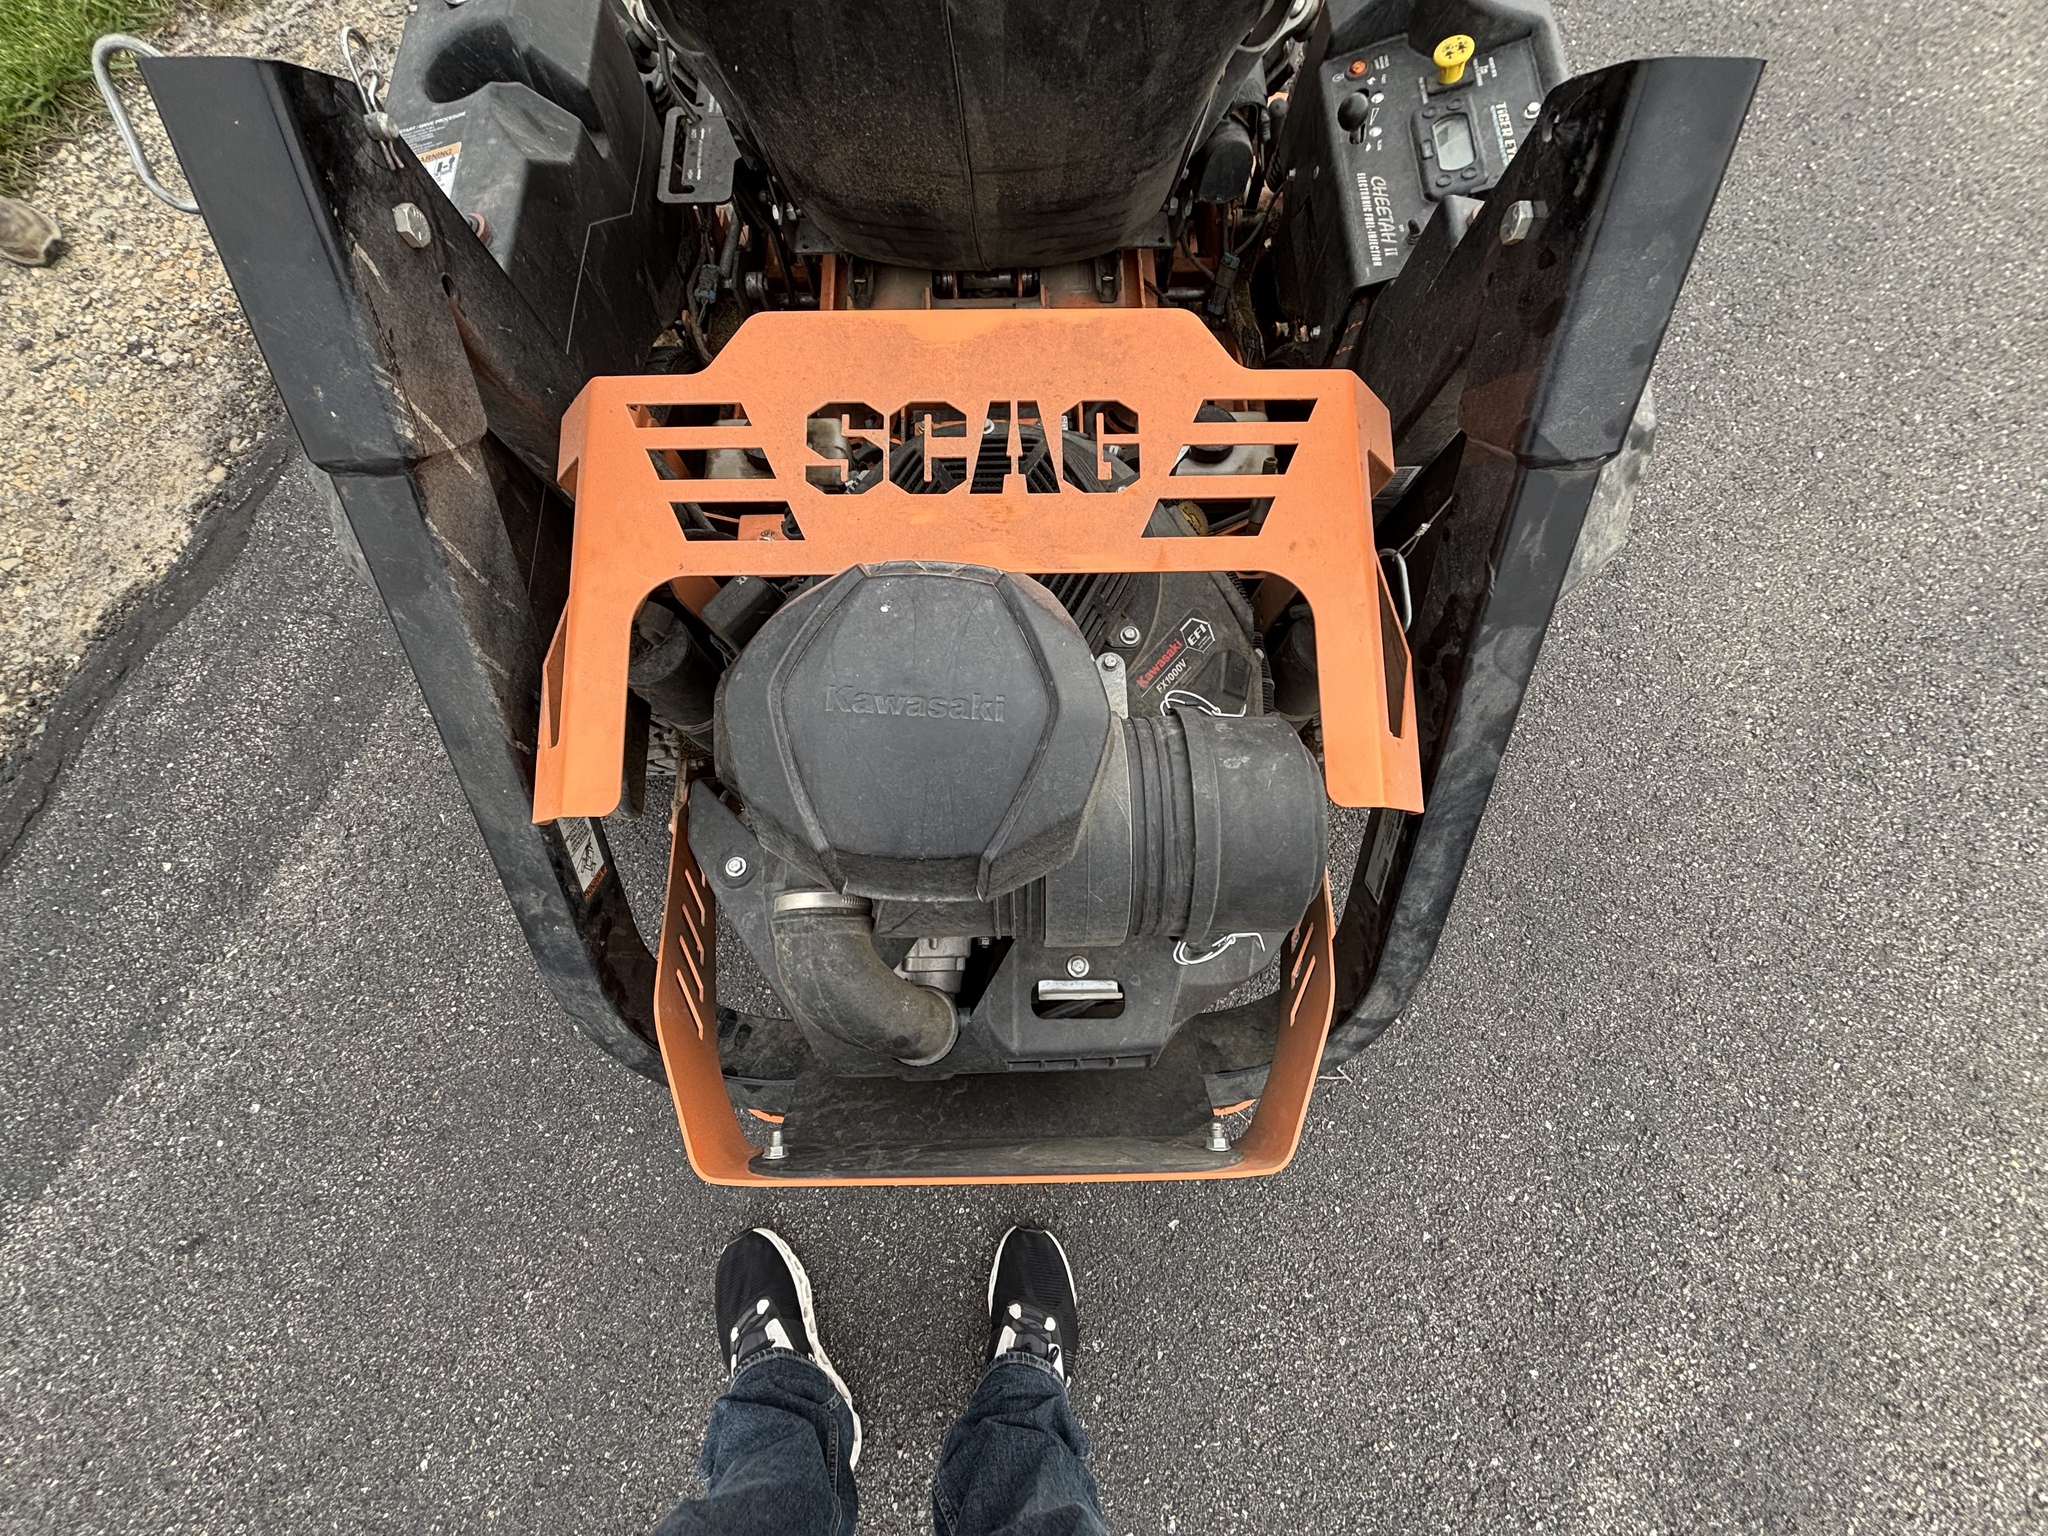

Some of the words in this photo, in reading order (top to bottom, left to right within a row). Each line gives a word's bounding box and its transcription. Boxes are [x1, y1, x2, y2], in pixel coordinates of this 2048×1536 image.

[420, 148, 452, 162] ARNING
[1356, 172, 1373, 213] ELECTRONIC
[1370, 176, 1398, 243] CHEETAH
[805, 400, 1141, 495] SCAG
[1187, 623, 1207, 646] EFI
[1136, 638, 1183, 688] Kawasaki
[1156, 658, 1187, 693] FX1000V
[824, 684, 1006, 723] Kawasaki
